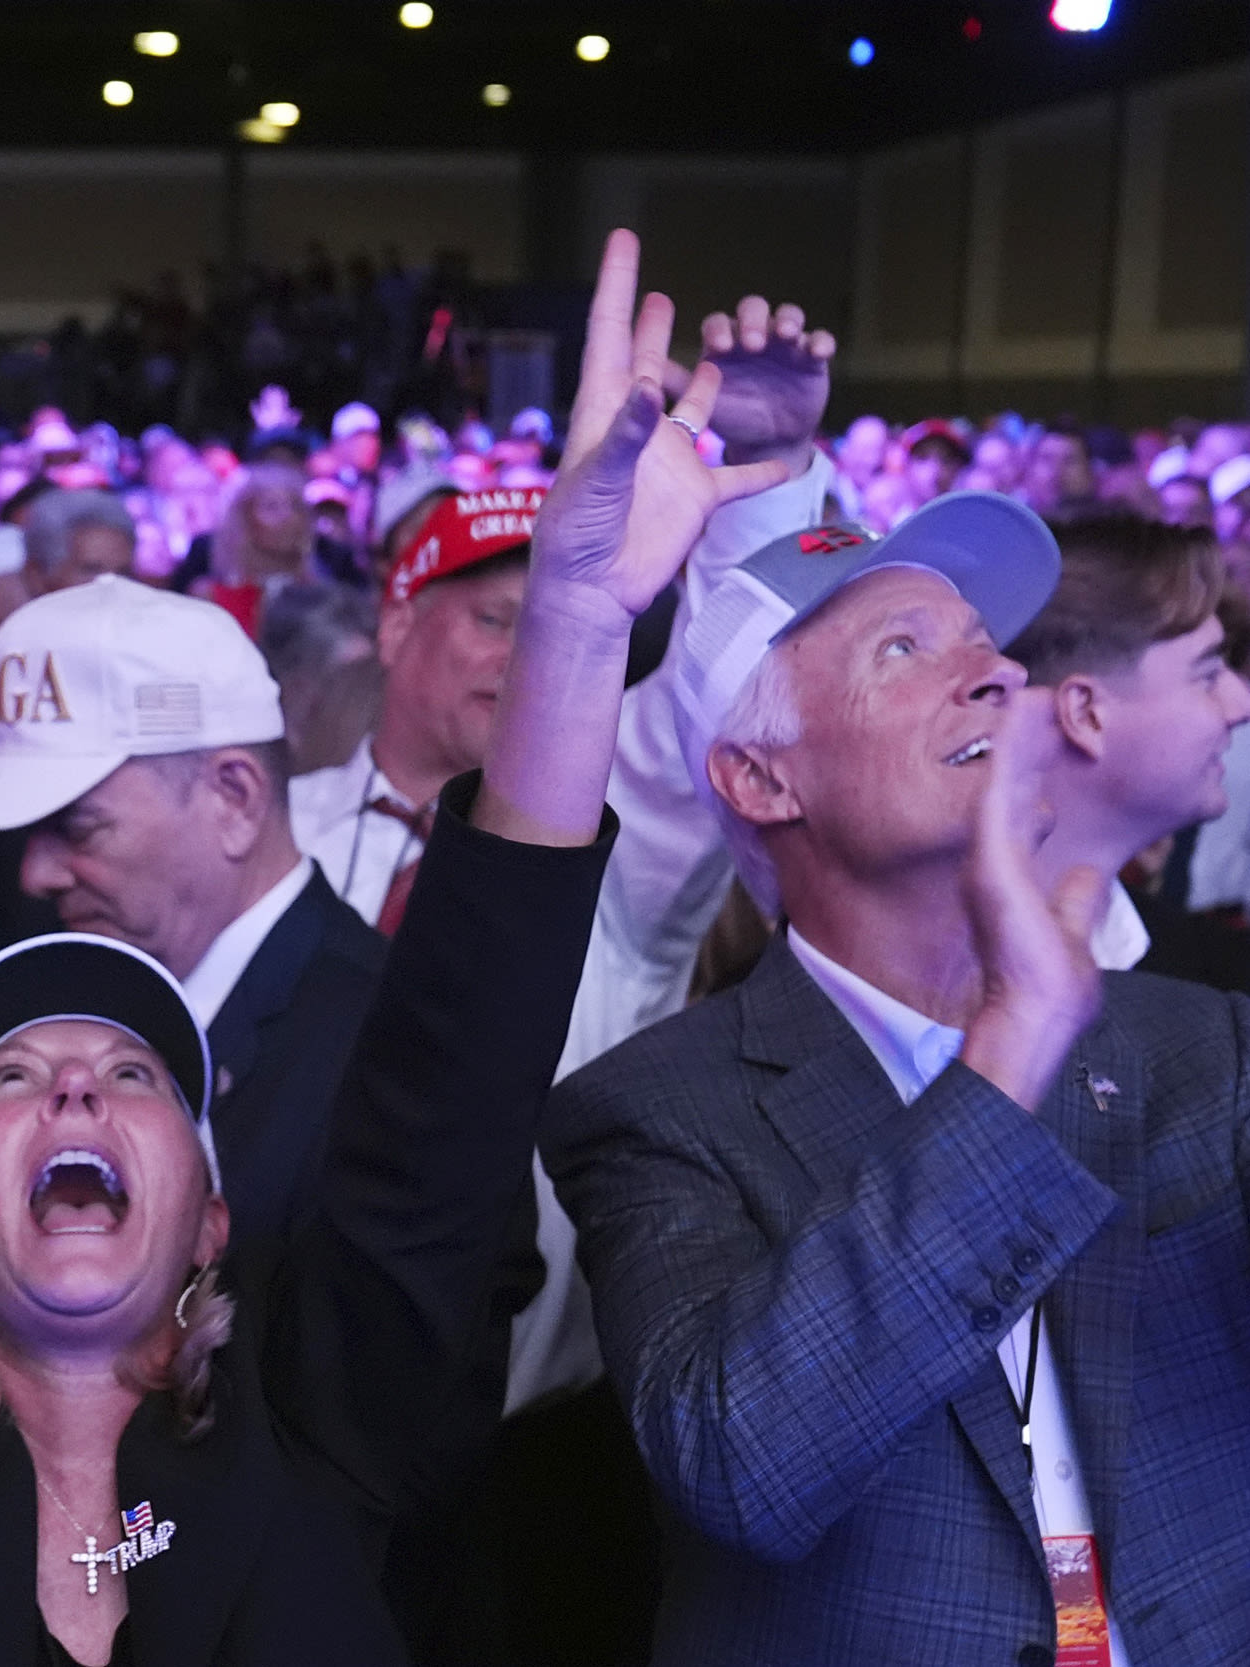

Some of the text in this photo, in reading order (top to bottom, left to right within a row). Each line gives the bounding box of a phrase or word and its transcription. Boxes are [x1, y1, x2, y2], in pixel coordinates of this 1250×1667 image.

[456, 489, 526, 515] MAKE
[470, 512, 533, 541] GREA
[104, 1520, 177, 1575] TRUMP
